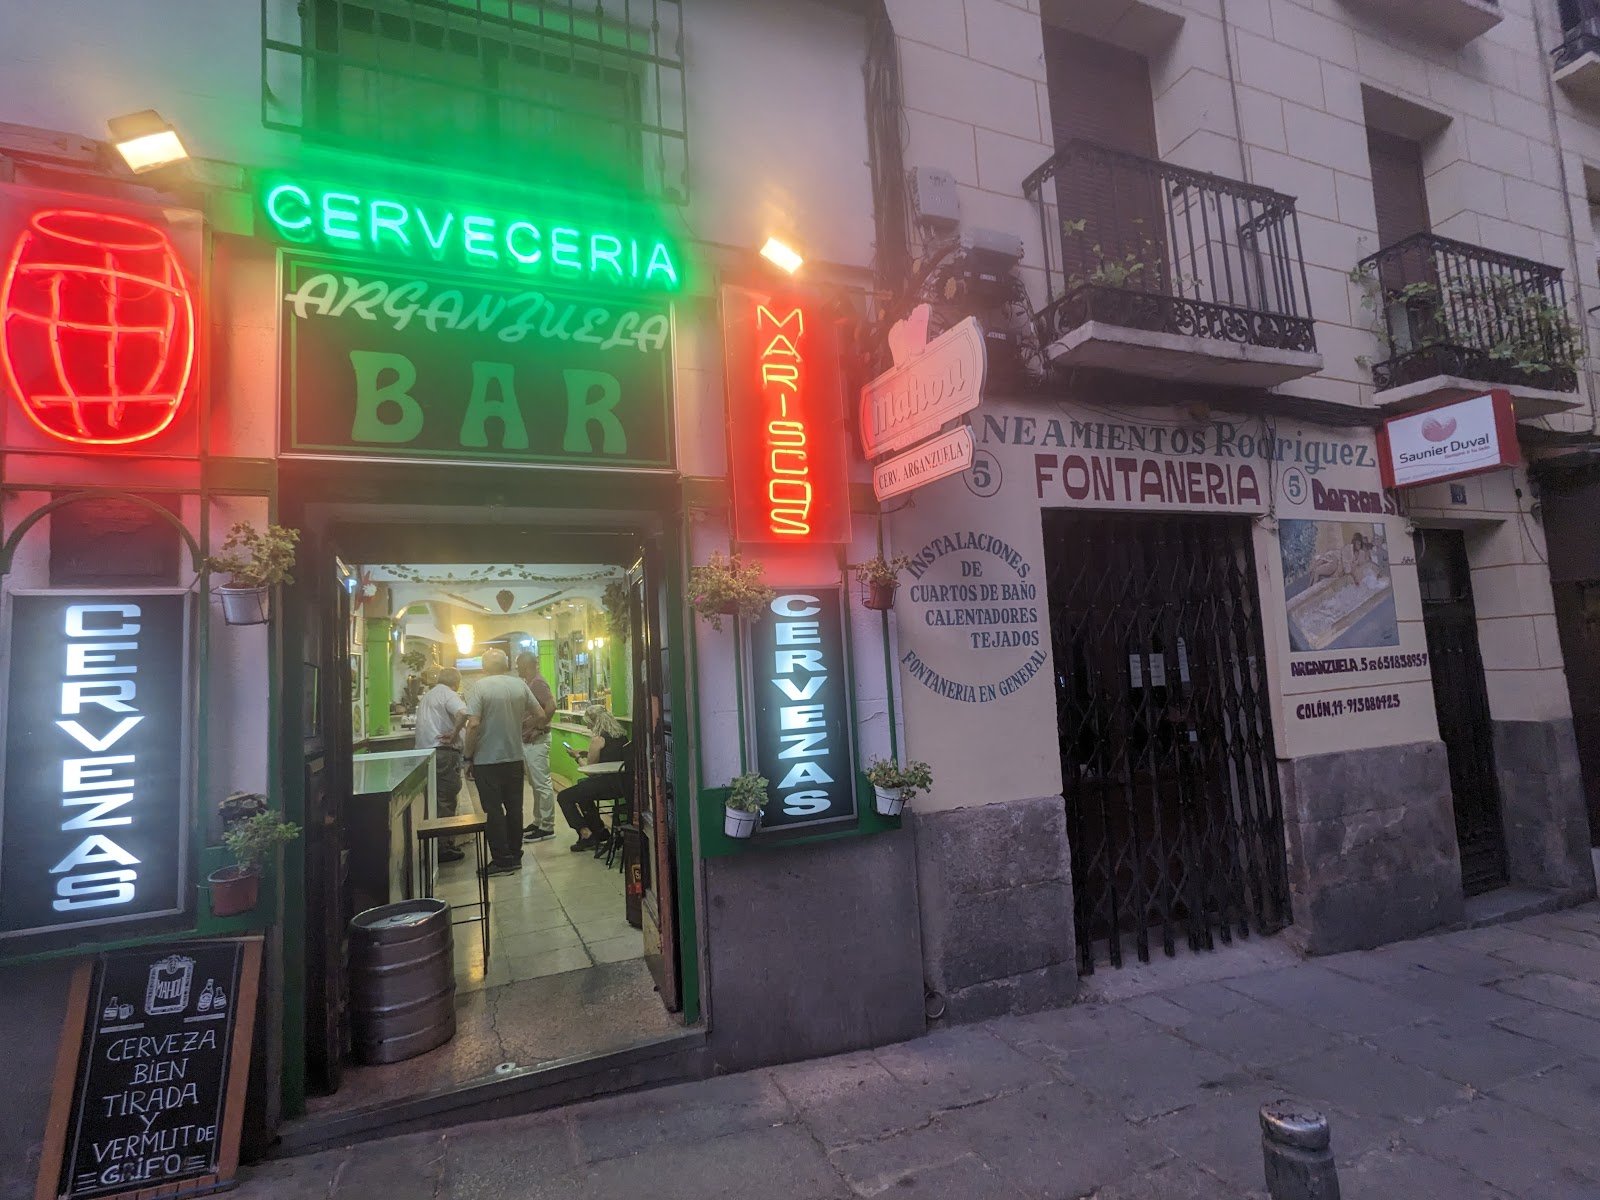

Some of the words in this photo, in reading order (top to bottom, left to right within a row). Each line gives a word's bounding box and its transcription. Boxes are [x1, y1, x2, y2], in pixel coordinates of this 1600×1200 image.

[267, 185, 677, 289] CERVECERIA
[285, 273, 669, 352] ARGANZUELA
[350, 350, 627, 455] BAR
[757, 305, 812, 535] MARISCOS
[877, 469, 901, 490] CERV.
[903, 440, 964, 480] ARGANZUELA
[962, 414, 1205, 455] NEAMIENTOS
[1214, 420, 1376, 475] Rodriguez
[1399, 445, 1449, 464] Saunier
[1450, 433, 1490, 452] Duval
[1034, 453, 1261, 507] FONTANERIA
[906, 531, 1030, 581] INSTALACIONES
[961, 560, 983, 578] DE
[910, 583, 978, 603] CUARTOS
[980, 583, 999, 602] DE
[1002, 580, 1037, 601] BAÑO
[925, 607, 1038, 627] CALENTADORES
[970, 630, 1040, 649] TEJADOS
[901, 650, 977, 703] FONTANERIA
[979, 684, 997, 703] EN
[999, 649, 1048, 697] GENERAL
[770, 594, 835, 817] CERVEZAS
[48, 604, 145, 912] CERVEZAS
[106, 1029, 217, 1062] CERVEZA
[93, 1125, 196, 1163] VERMUT
[196, 1126, 216, 1143] DE
[140, 1111, 162, 1134] Y
